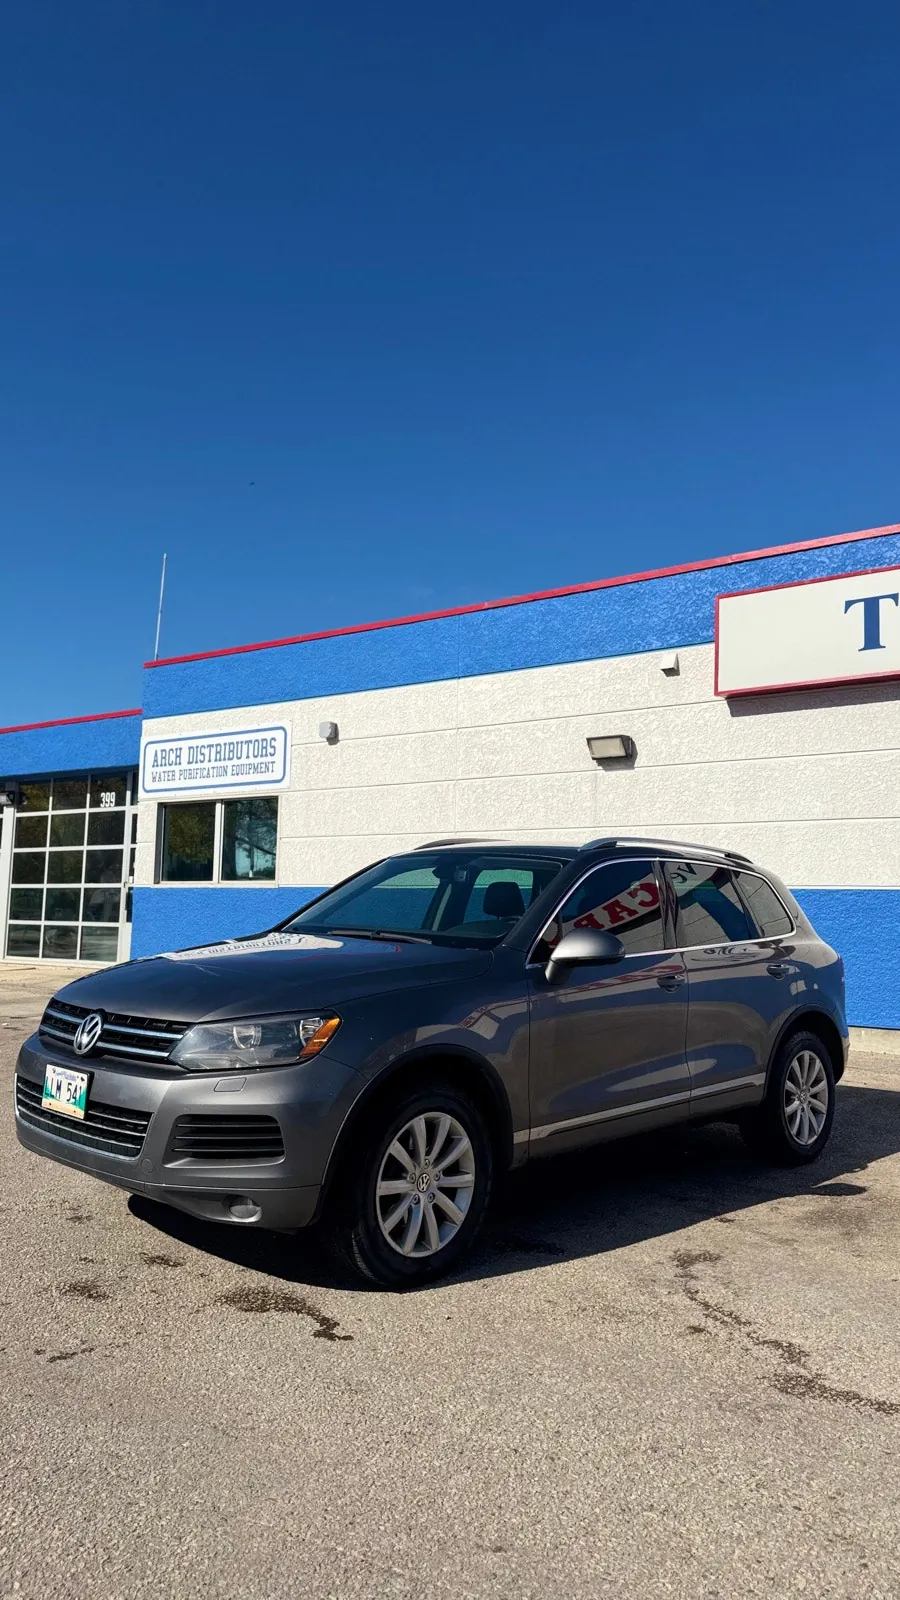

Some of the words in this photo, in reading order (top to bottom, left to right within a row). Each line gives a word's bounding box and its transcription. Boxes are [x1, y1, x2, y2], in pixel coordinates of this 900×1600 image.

[844, 592, 899, 652] T
[152, 747, 182, 768] ARCH
[187, 737, 277, 765] DISTRIBUTORS
[151, 770, 176, 783] WATER
[178, 765, 229, 781] PURIFICATION
[231, 761, 276, 777] EQUIPMENT
[100, 791, 116, 808] 399
